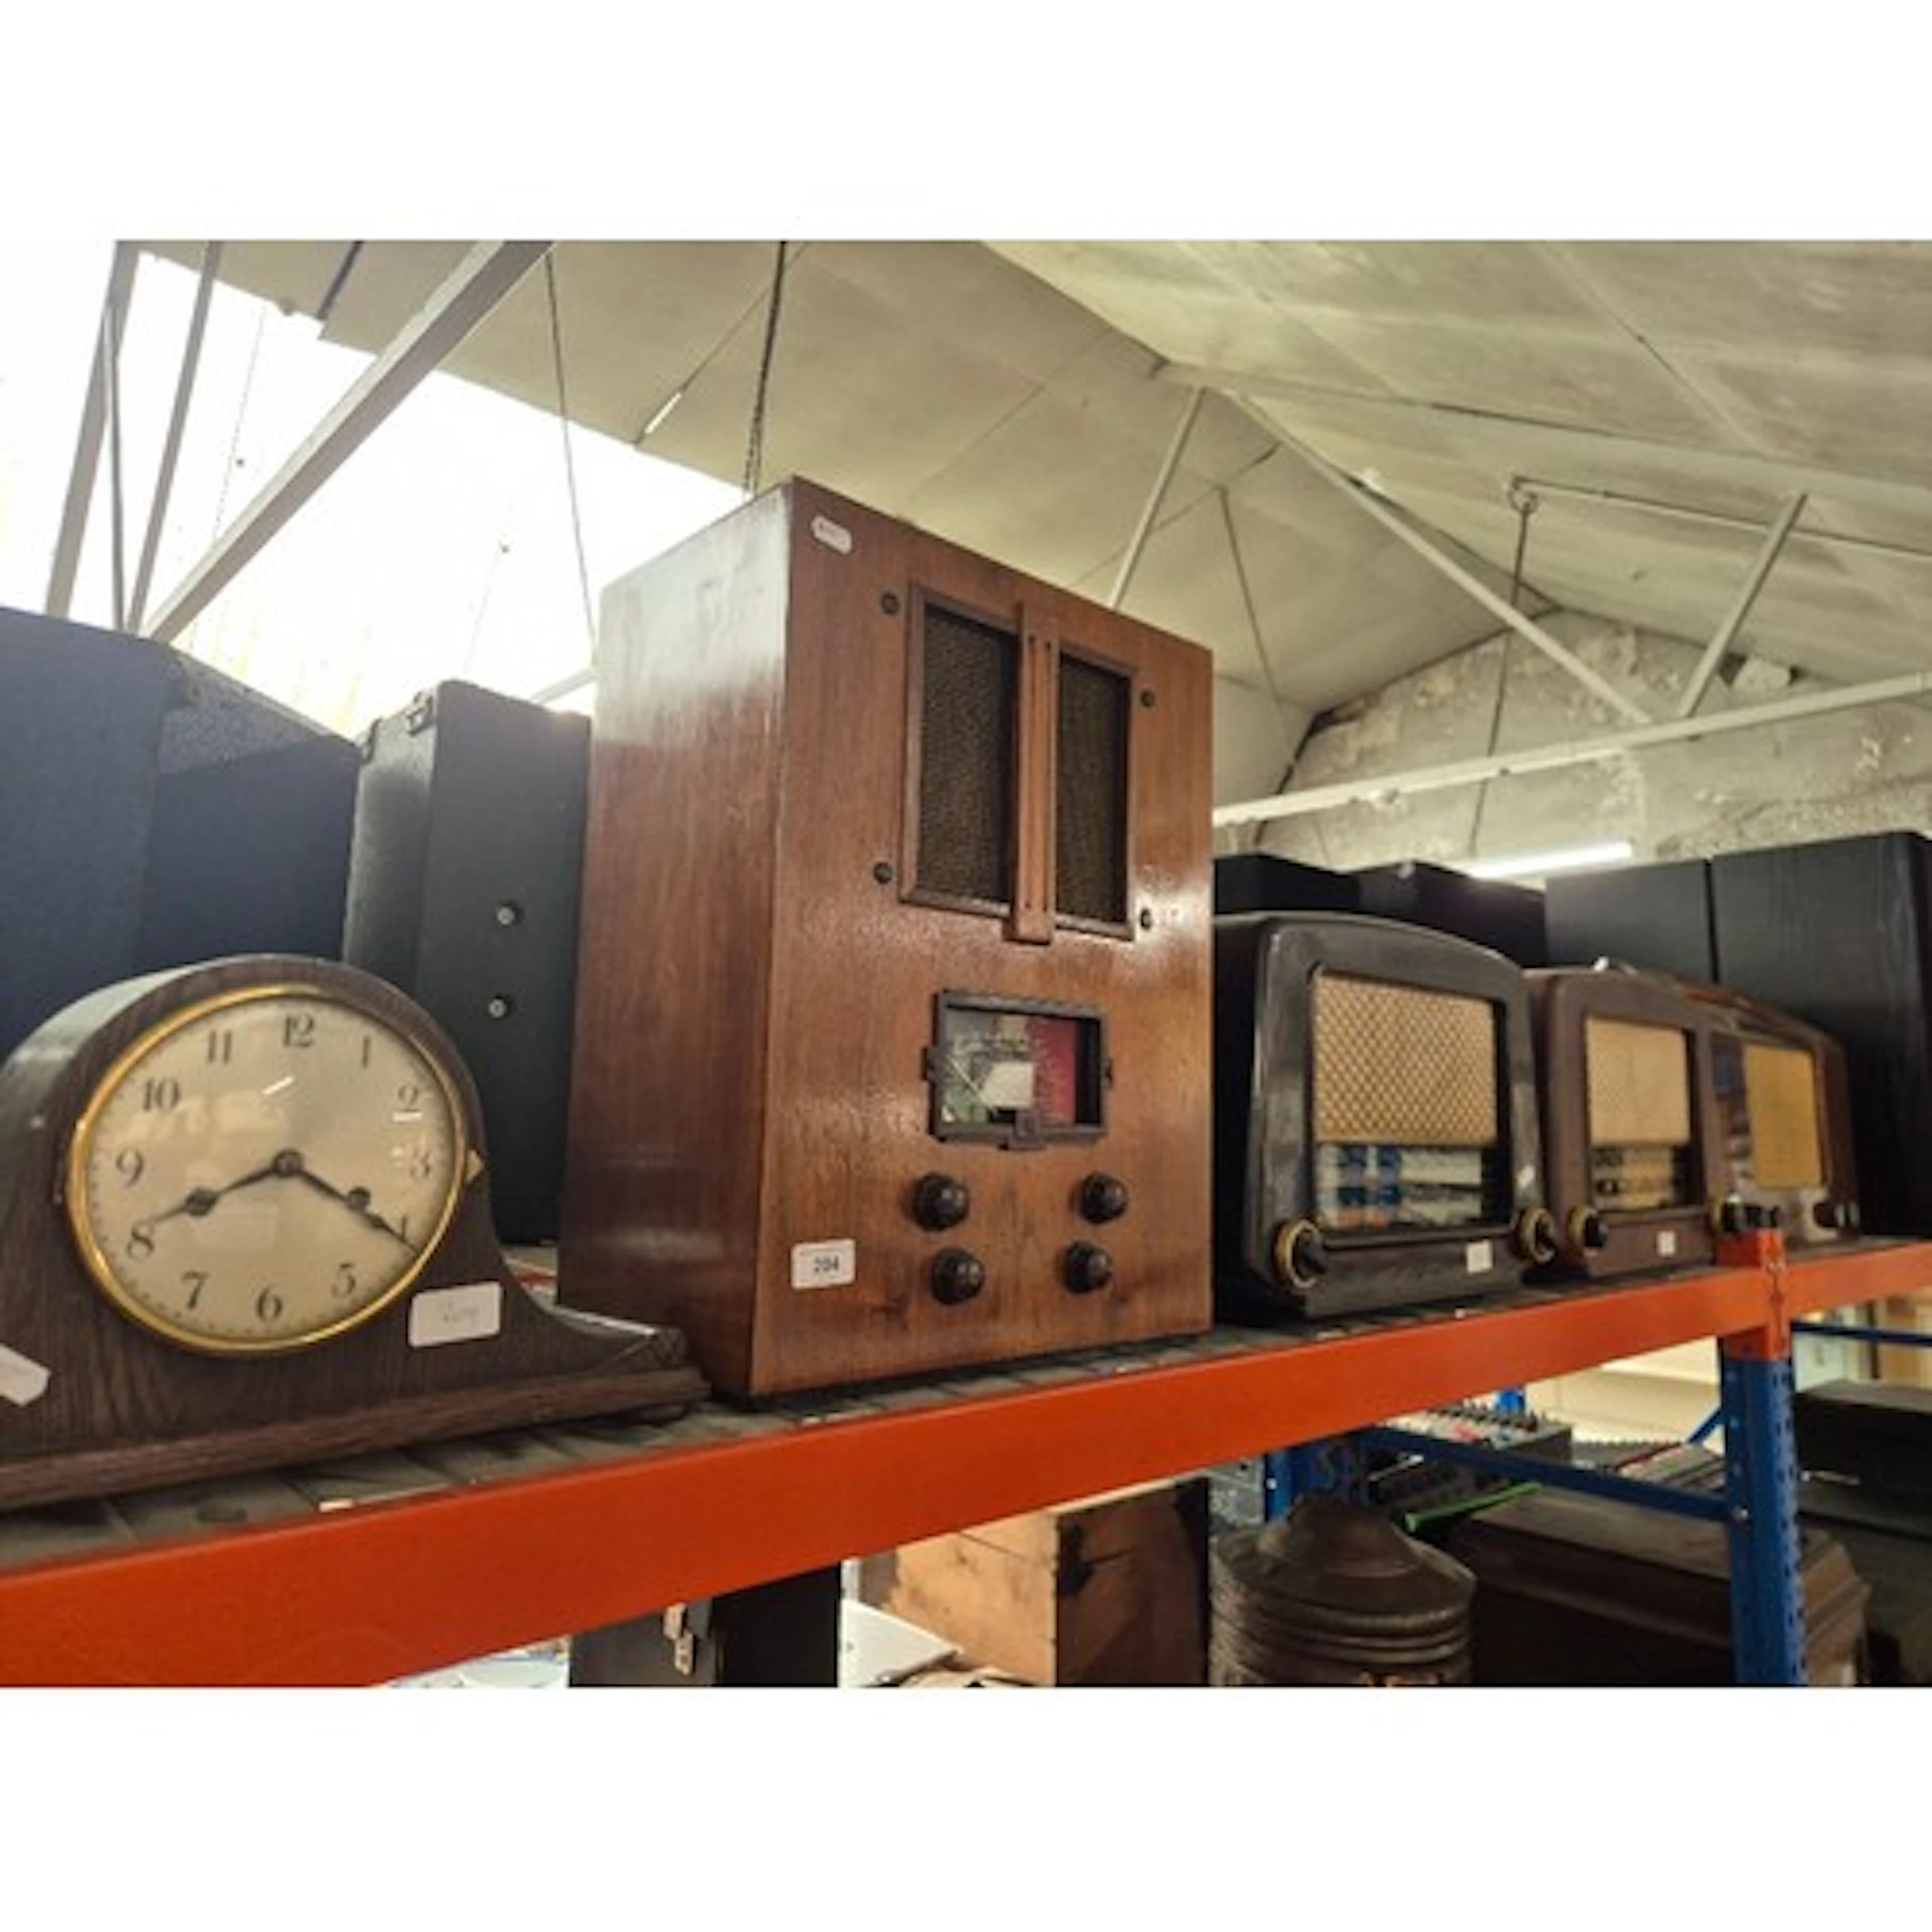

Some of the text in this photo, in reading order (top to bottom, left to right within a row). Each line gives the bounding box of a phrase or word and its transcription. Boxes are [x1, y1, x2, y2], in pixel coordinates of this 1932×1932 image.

[283, 1013, 315, 1047] 12
[207, 1031, 233, 1063] 11
[361, 1035, 371, 1068] 1
[143, 1079, 181, 1111] 10
[116, 1150, 143, 1185] 9
[410, 1150, 431, 1180] 3
[126, 1221, 155, 1260] 8
[182, 1271, 208, 1310] 7
[332, 1263, 356, 1296] 5
[256, 1286, 283, 1322] 6
